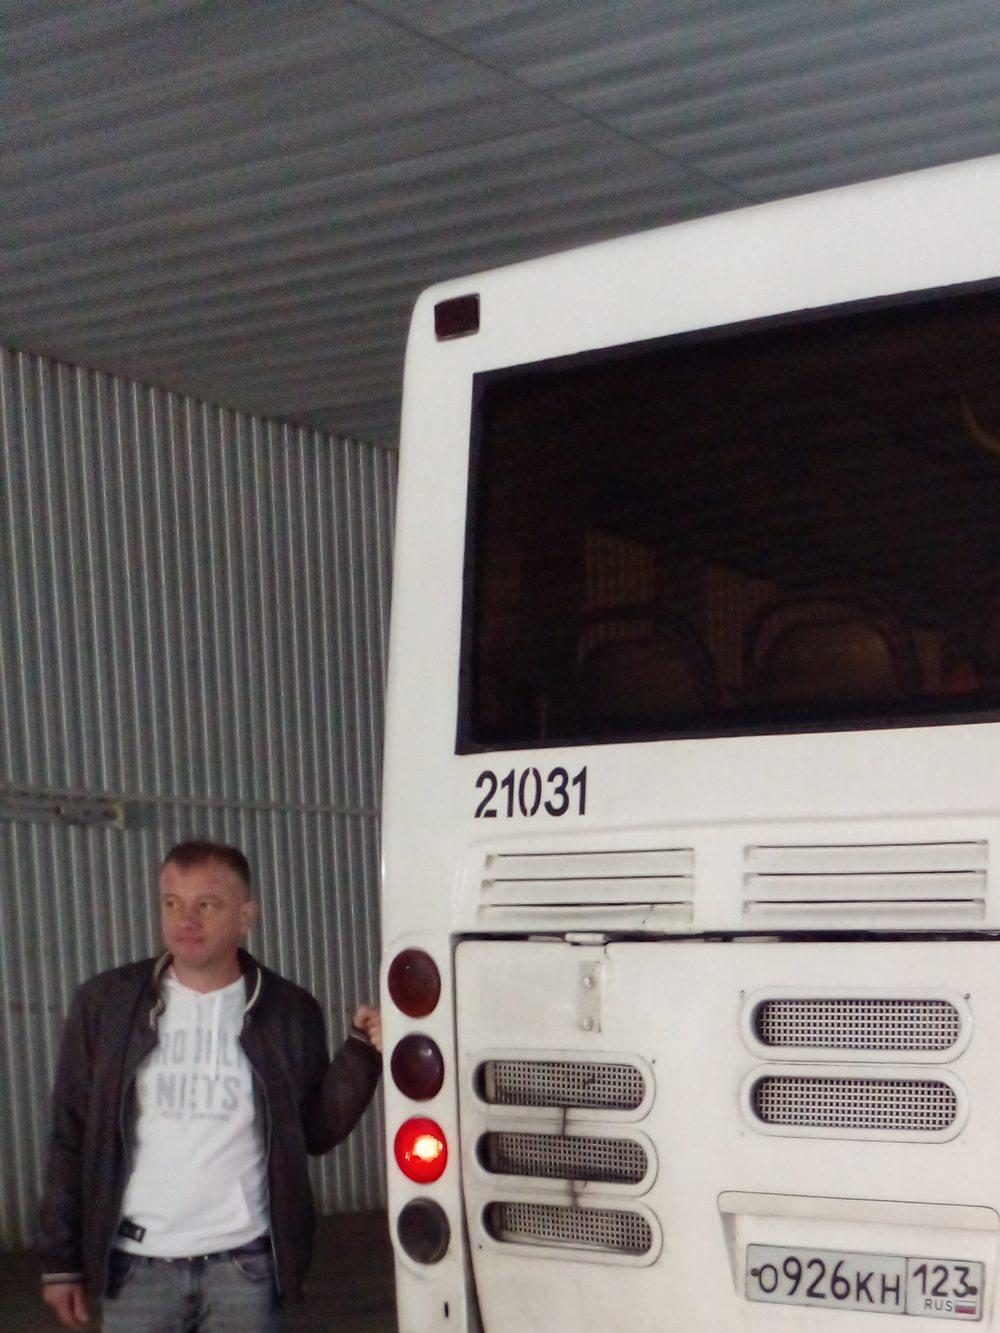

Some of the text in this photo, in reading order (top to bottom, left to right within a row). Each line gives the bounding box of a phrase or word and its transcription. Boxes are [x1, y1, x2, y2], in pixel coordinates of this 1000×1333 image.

[474, 765, 587, 818] 21031
[913, 1264, 971, 1298] 123
[924, 1298, 953, 1313] RUS
